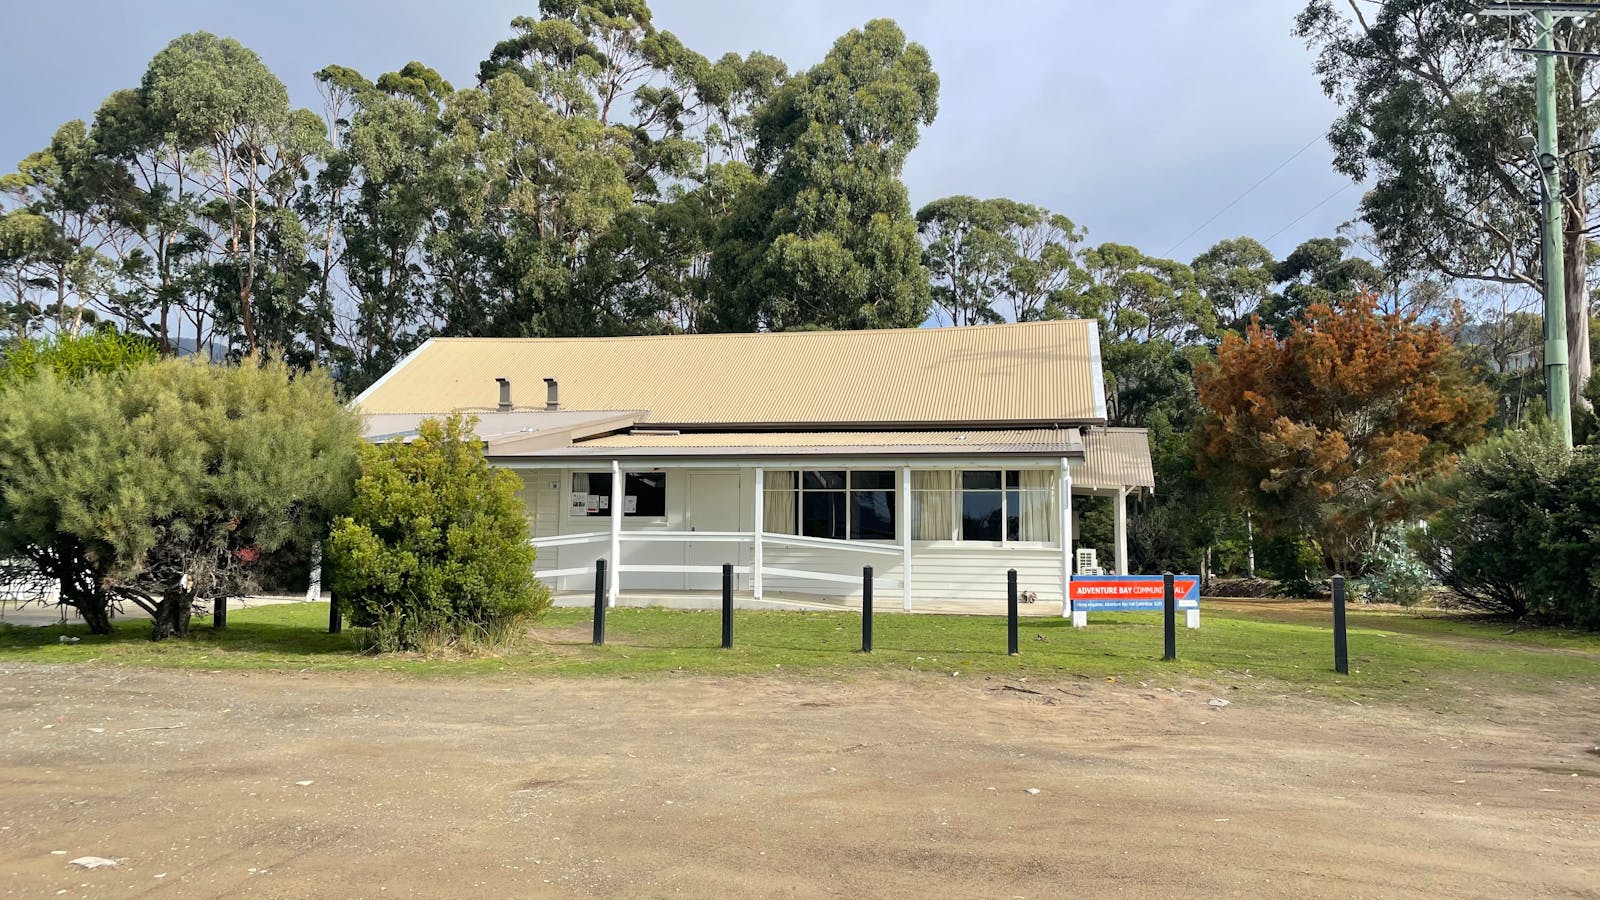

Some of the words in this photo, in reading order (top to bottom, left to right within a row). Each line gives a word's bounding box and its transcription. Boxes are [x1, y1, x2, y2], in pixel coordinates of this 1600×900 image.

[1077, 586, 1118, 595] ADVENTURE
[1119, 586, 1133, 594] BAY
[1133, 586, 1164, 594] COMMUNIT
[1174, 586, 1185, 594] ALL
